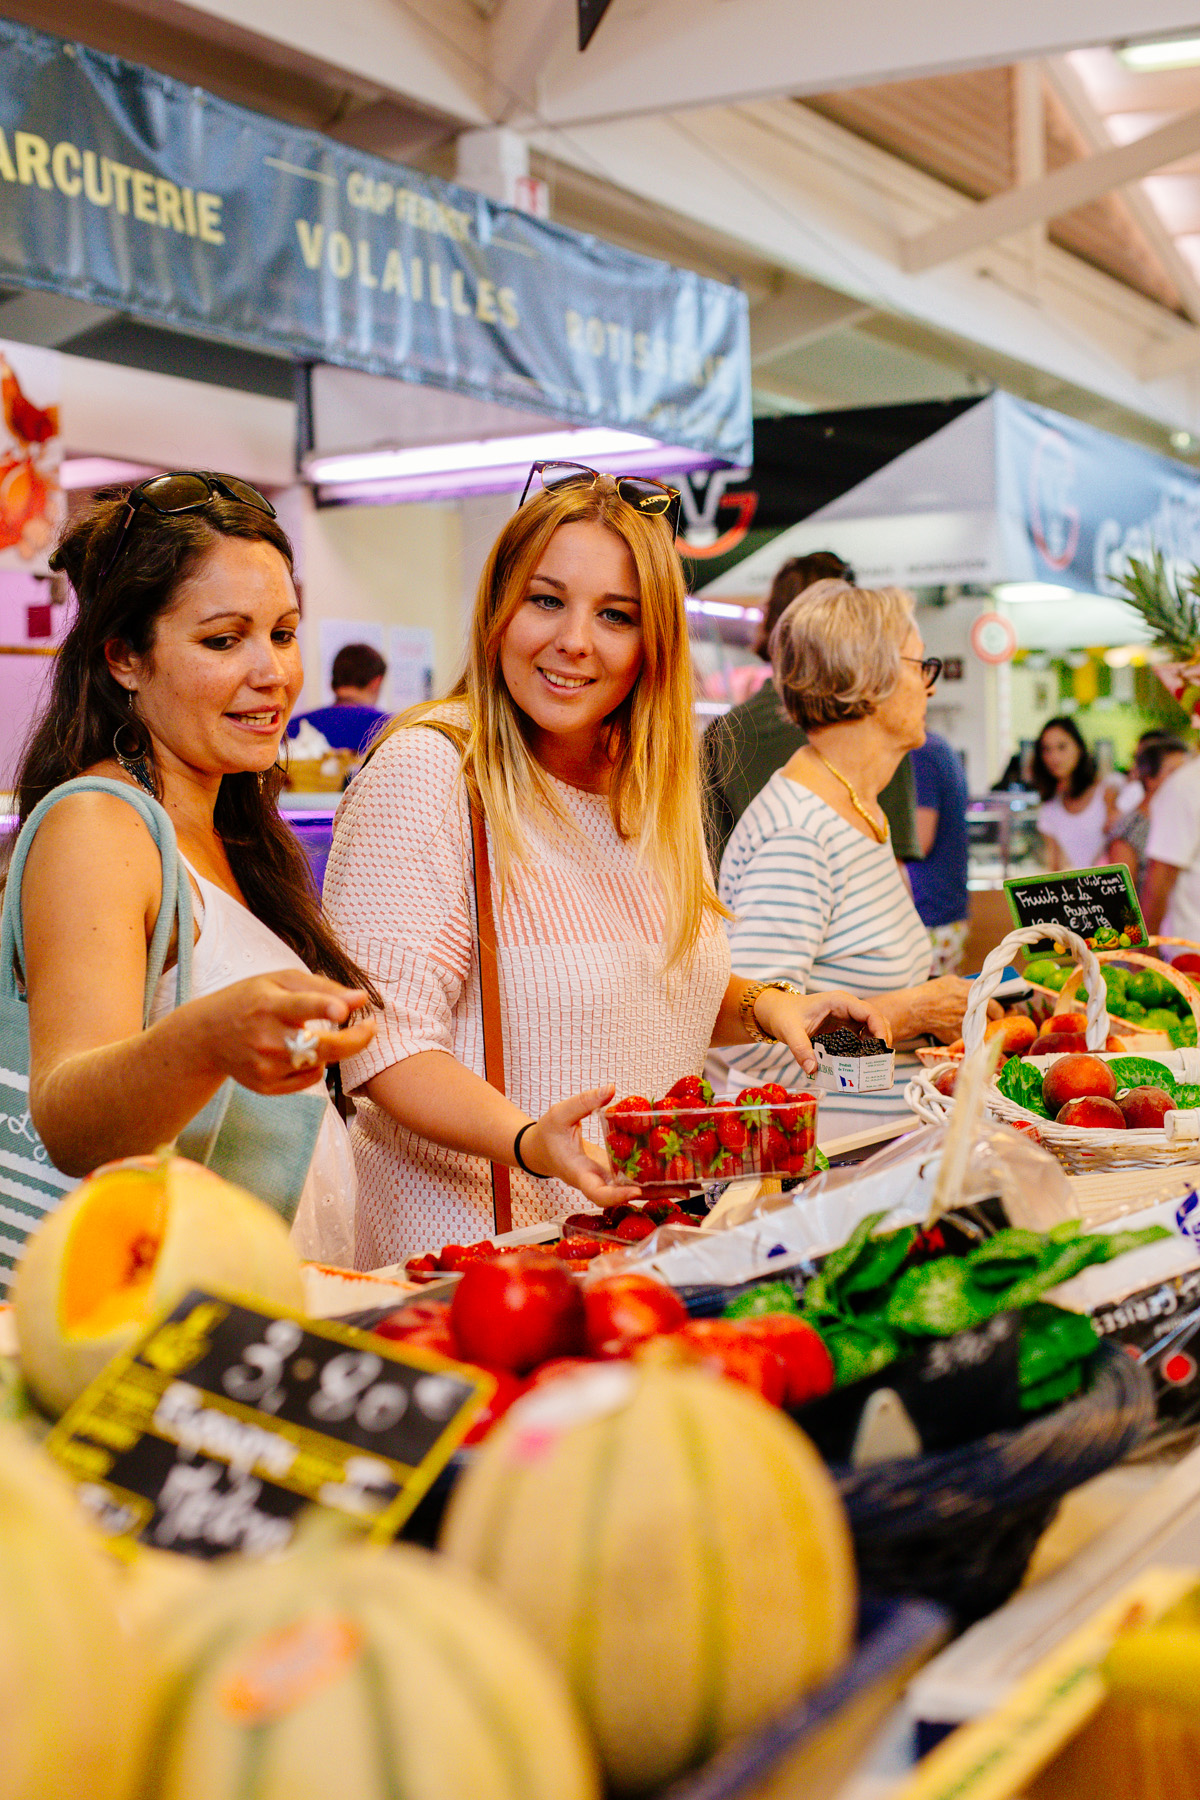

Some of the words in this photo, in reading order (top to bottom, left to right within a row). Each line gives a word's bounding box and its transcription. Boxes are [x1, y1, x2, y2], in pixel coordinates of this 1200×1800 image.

[295, 219, 520, 329] VOLAILLES
[1015, 886, 1059, 908] Fruits
[1061, 885, 1075, 902] de
